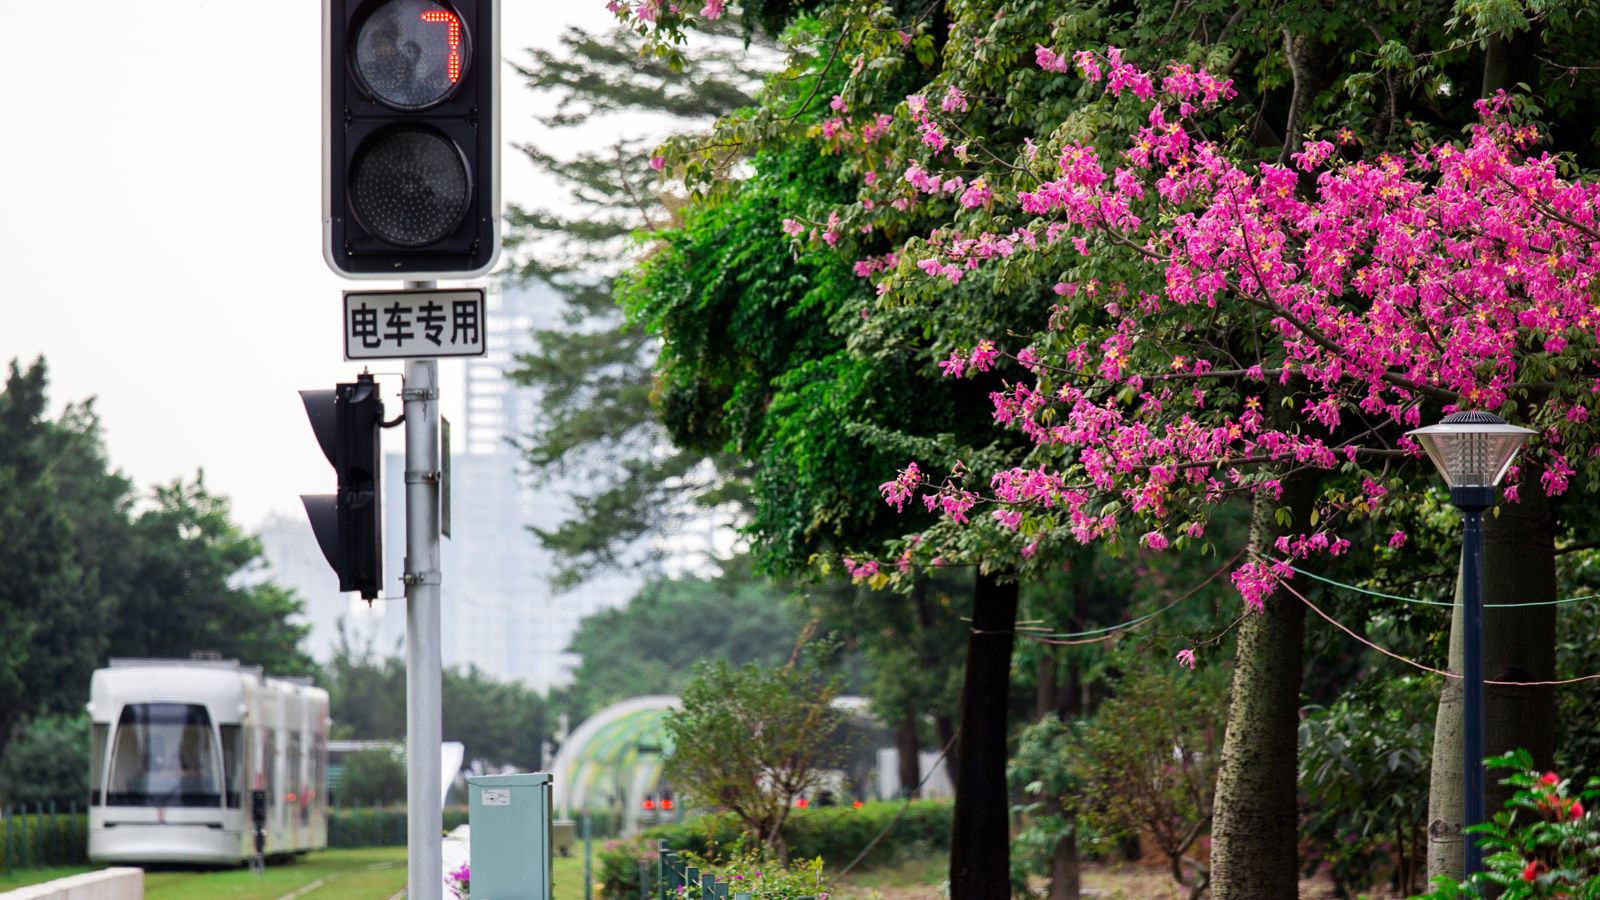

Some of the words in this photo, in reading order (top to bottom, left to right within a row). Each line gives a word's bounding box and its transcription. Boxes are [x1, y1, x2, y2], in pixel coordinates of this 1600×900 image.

[421, 11, 460, 83] 7
[351, 300, 479, 349] 电车专用
